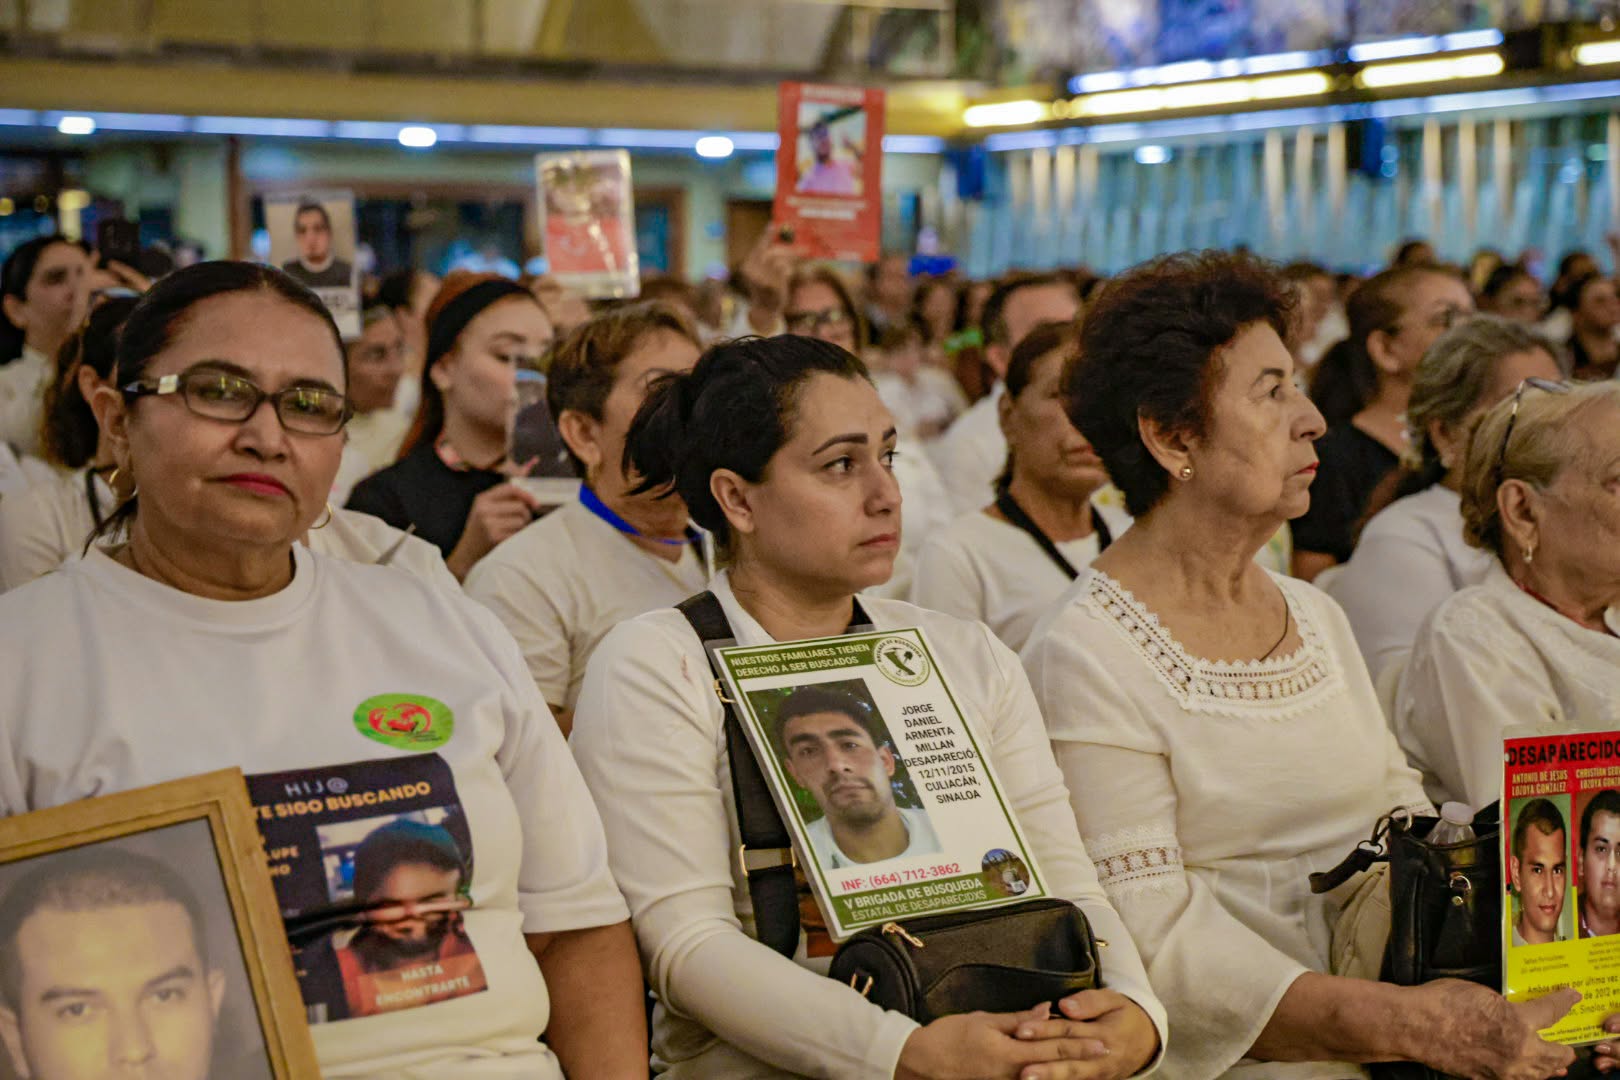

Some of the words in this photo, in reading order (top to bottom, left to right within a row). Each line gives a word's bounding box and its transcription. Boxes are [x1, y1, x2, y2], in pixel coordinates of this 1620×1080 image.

[730, 653, 781, 667] NUESTROS
[782, 649, 836, 663] FAMILIARES
[838, 643, 870, 656] TIENEN
[736, 665, 777, 678] DERECHO
[781, 663, 790, 672] A
[790, 662, 808, 672] SER
[809, 656, 859, 669] BUSCADOS
[901, 703, 935, 716] JORGE
[904, 715, 942, 728] DANIEL
[905, 726, 955, 741] ARMENTA
[915, 739, 955, 753] MILLAN
[904, 748, 977, 768] DESAPARECIÓ:
[918, 762, 975, 779] 12/11/2015
[1512, 772, 1538, 784] ANTONIO
[1540, 771, 1548, 782] DE
[925, 775, 981, 792] CULIACÁN,
[275, 799, 323, 818] SIGO
[325, 781, 431, 812] BUSCANDO
[936, 789, 981, 804] SINALOA
[841, 878, 867, 891] INF:
[868, 871, 902, 889] (664)
[903, 863, 961, 882] 712-3862
[843, 898, 854, 909] V
[854, 890, 906, 908] BRIGADA
[907, 887, 922, 901] DE
[924, 877, 984, 898] BÚSQUEDA
[851, 906, 895, 921] ESTATAL
[897, 903, 911, 916] DE
[911, 889, 987, 911] DESAPARECIDXS
[402, 964, 443, 981] HASTA
